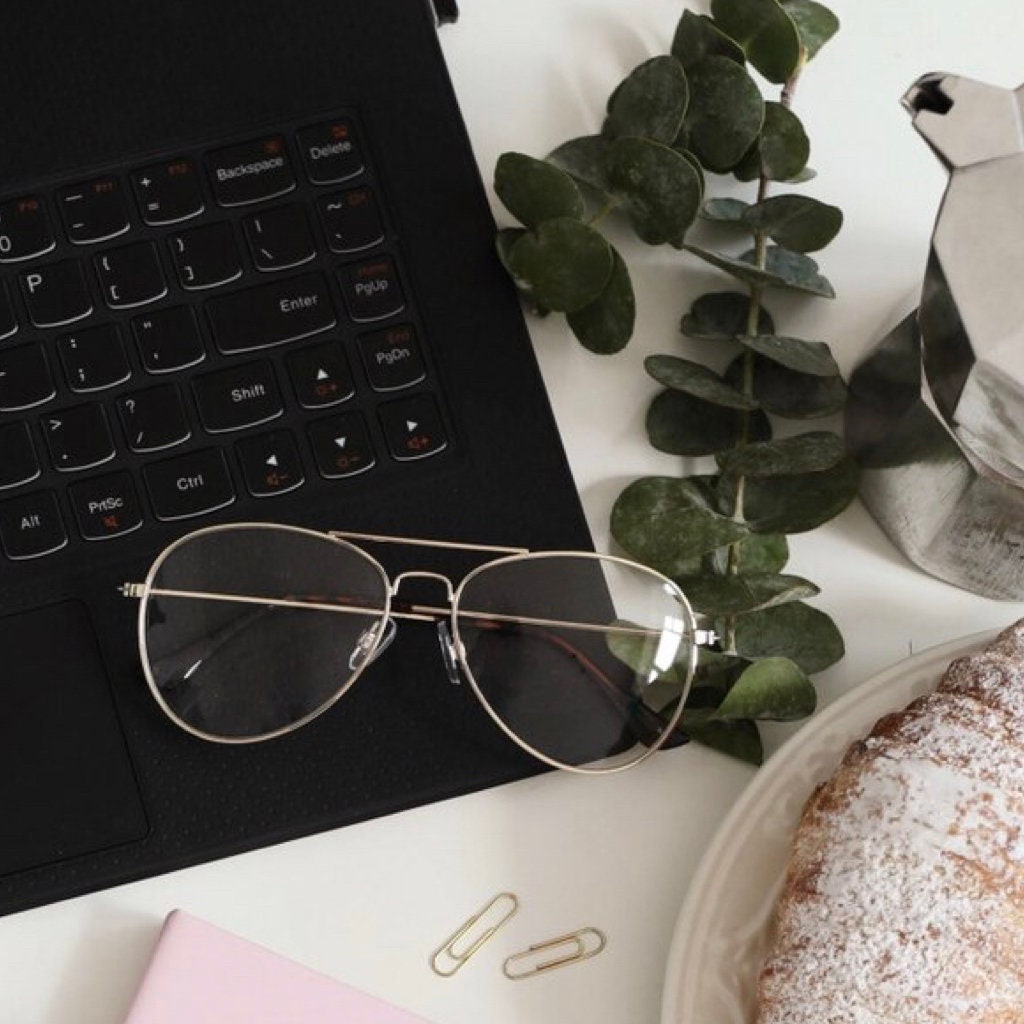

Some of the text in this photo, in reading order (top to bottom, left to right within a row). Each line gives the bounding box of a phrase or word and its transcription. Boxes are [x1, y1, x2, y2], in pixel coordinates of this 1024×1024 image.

[310, 141, 351, 160] Delete
[217, 157, 284, 181] Backspace
[27, 274, 42, 294] P
[355, 279, 389, 296] PgUp
[279, 294, 319, 313] Enter
[376, 348, 411, 365] PgDn
[231, 384, 267, 403] Shift
[176, 474, 205, 491] Ctrl
[88, 496, 125, 515] PrtSc
[20, 515, 41, 530] Alt
